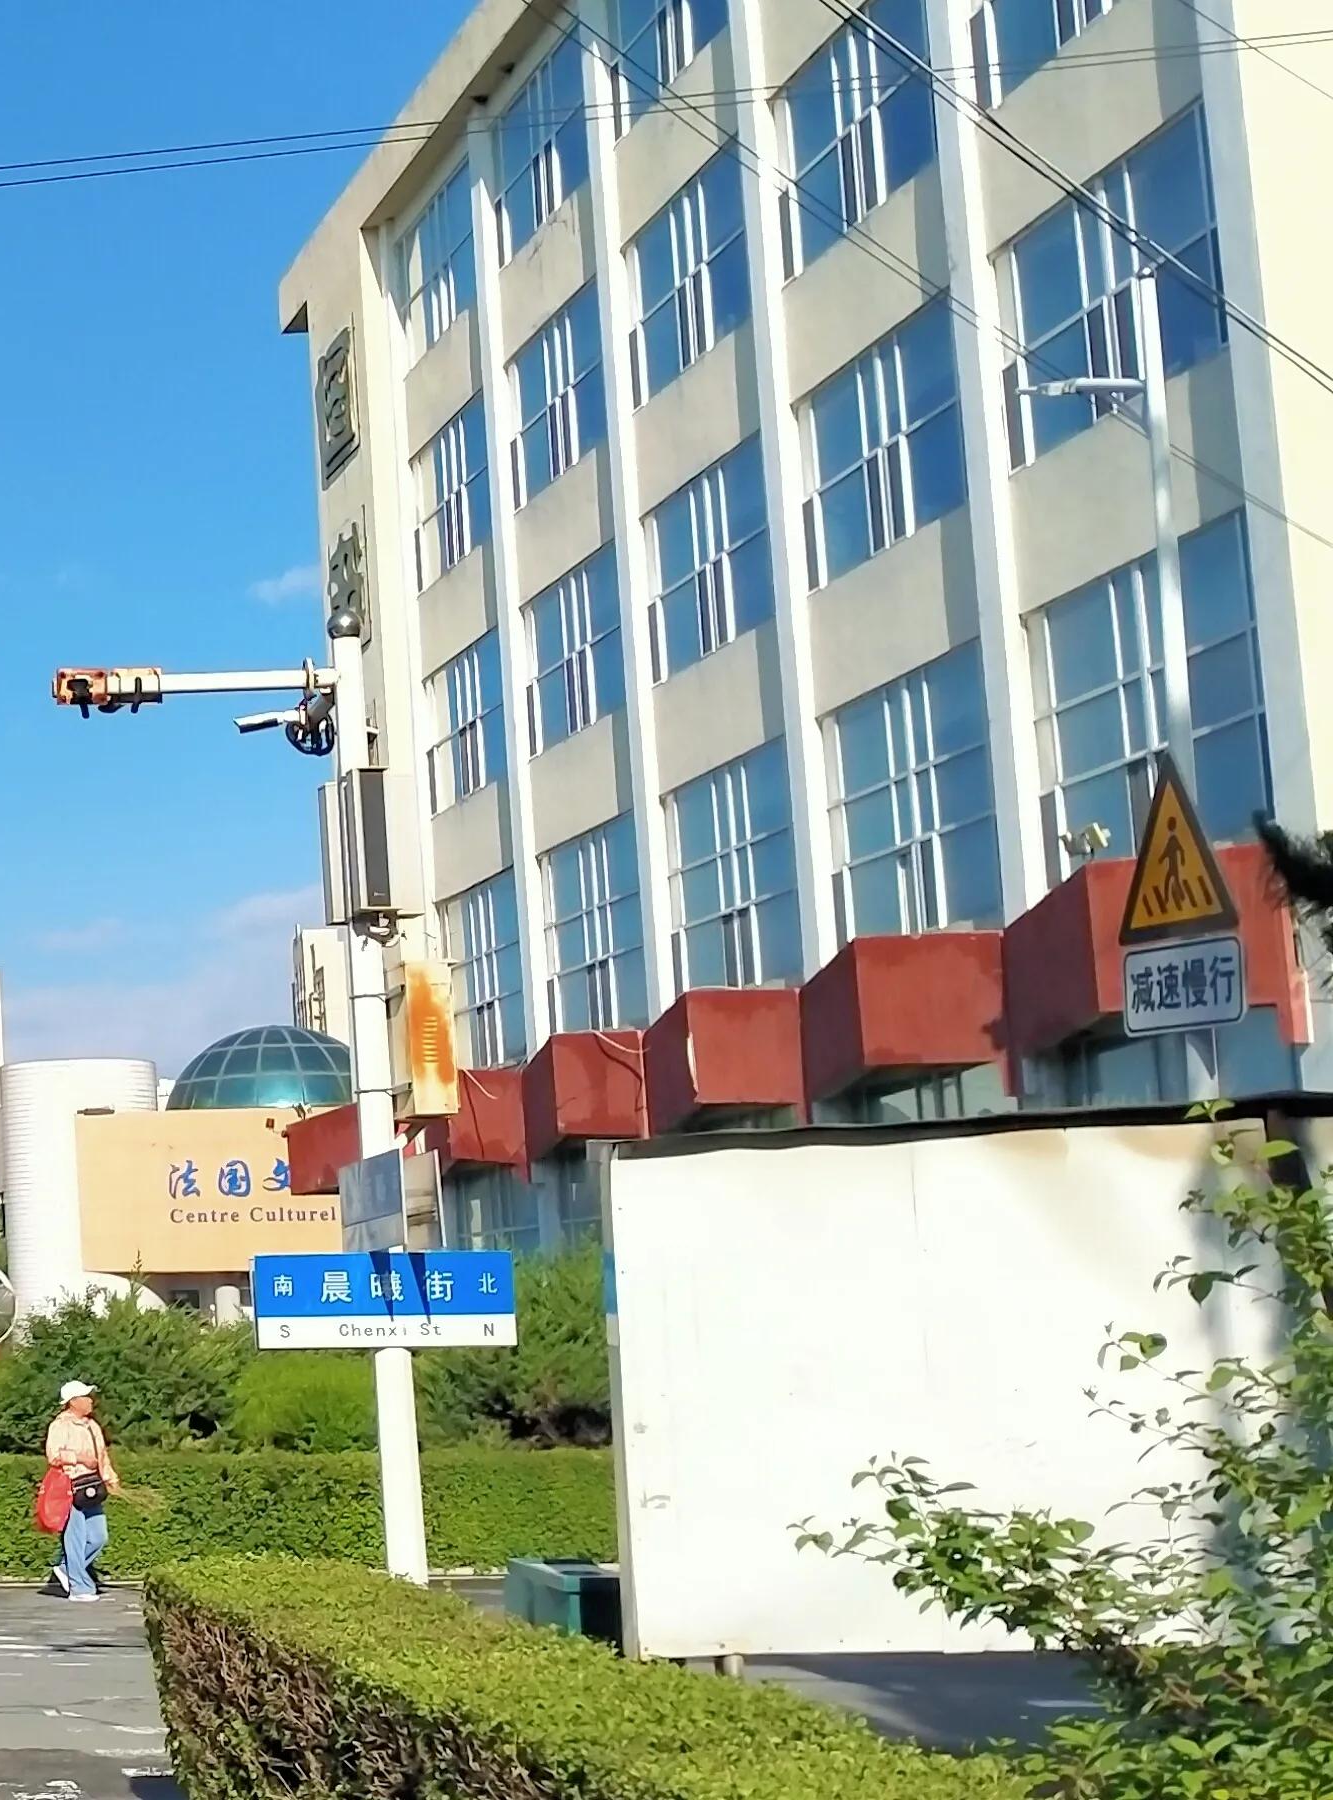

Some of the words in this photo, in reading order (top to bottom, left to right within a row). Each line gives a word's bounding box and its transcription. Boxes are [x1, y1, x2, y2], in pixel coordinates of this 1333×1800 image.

[1130, 955, 1235, 1014] 减速慢行
[170, 1208, 240, 1224] Centre
[250, 1206, 337, 1223] Culturel
[272, 1274, 294, 1298] 南
[320, 1269, 455, 1303] 晨曦街
[477, 1272, 499, 1295] 北
[279, 1324, 291, 1339] S
[338, 1323, 408, 1338] Chenxi
[420, 1322, 442, 1337] St
[483, 1323, 495, 1337] N
